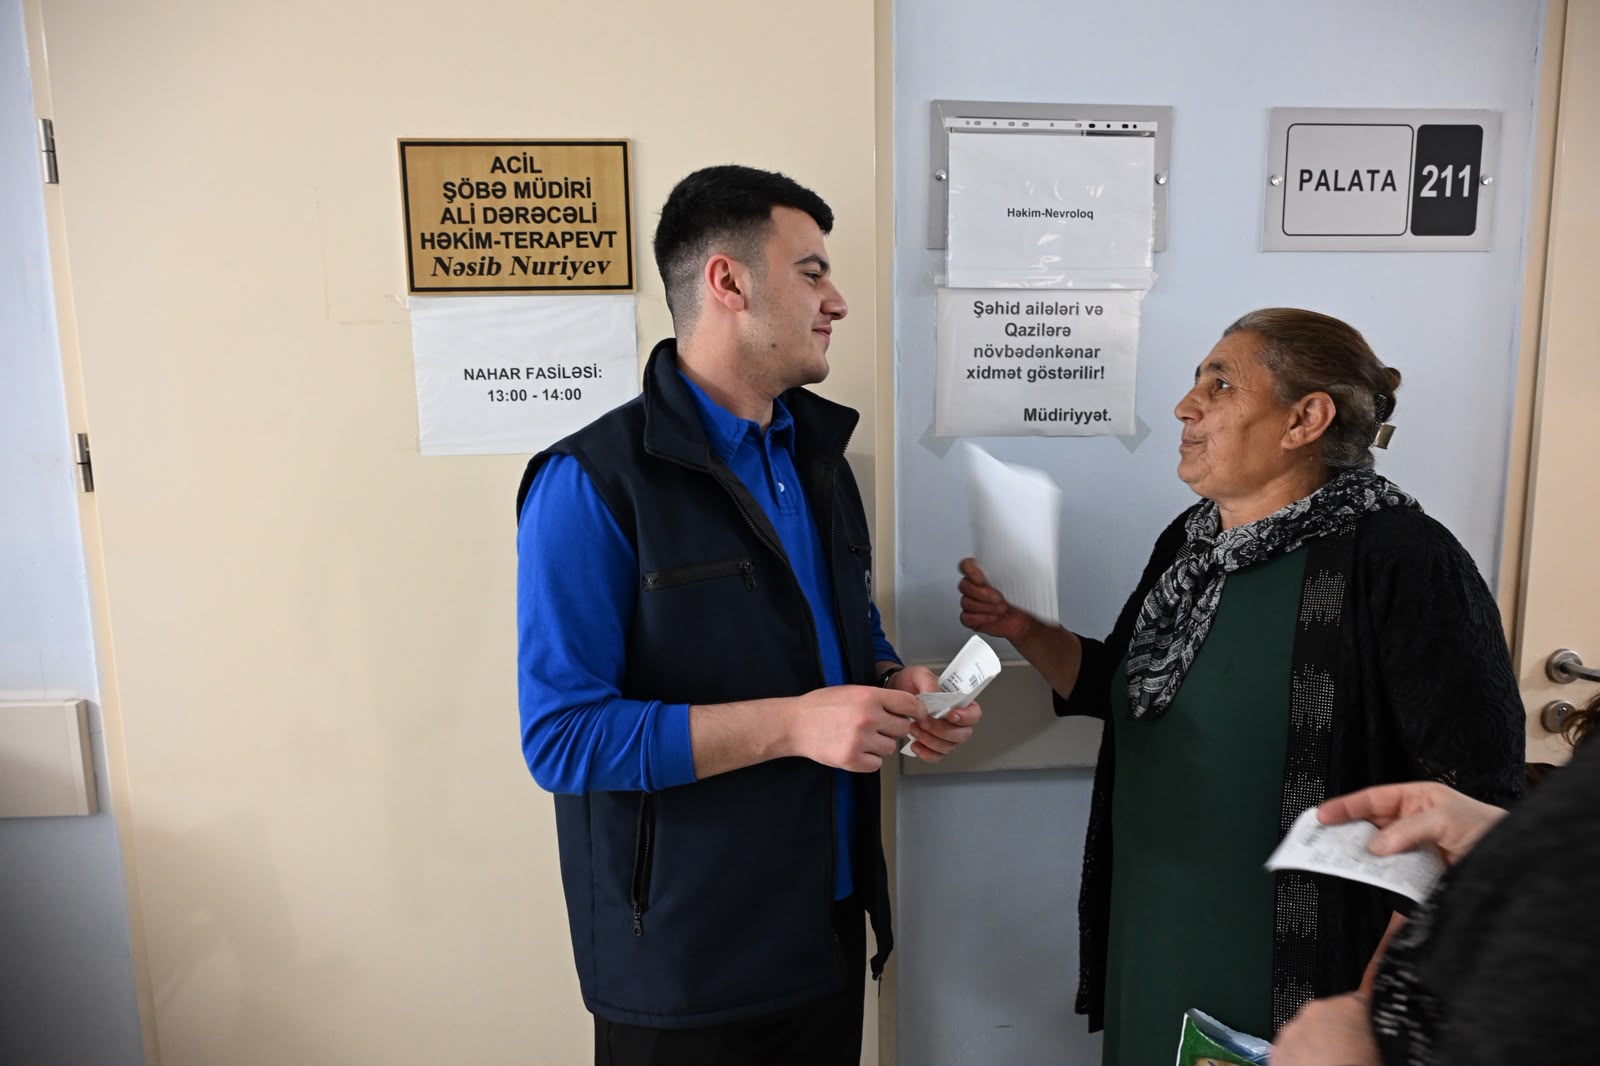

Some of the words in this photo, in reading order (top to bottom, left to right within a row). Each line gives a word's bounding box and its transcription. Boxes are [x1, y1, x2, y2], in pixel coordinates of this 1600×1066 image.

[490, 152, 542, 174] ACİL
[443, 178, 507, 203] ŞÖBƏ
[514, 177, 591, 199] MÜDİRİ
[1298, 169, 1397, 192] PALATA
[1420, 164, 1471, 198] 211
[440, 203, 475, 225] ALİ
[483, 202, 597, 224] DƏRƏCƏLİ
[1007, 208, 1094, 220] Həkim-Nevroloq
[420, 228, 617, 250] HƏKİM-TERAPEVT
[430, 256, 502, 277] Nəsib
[509, 255, 611, 281] Nuriyev
[973, 300, 1020, 318] Şəhid
[1025, 301, 1080, 316] ailələri
[1085, 304, 1104, 316] və
[1004, 322, 1071, 337] Qazilərə
[973, 344, 1101, 359] növbədənkənar
[464, 367, 520, 381] NAHAR
[526, 363, 602, 380] FASİLƏSİ:
[966, 365, 1022, 380] xidmət
[1027, 366, 1105, 383] göstərilir!
[487, 389, 527, 402] 13:00
[542, 388, 582, 401] 14:00
[1023, 408, 1112, 425] Müdiriyyət.
